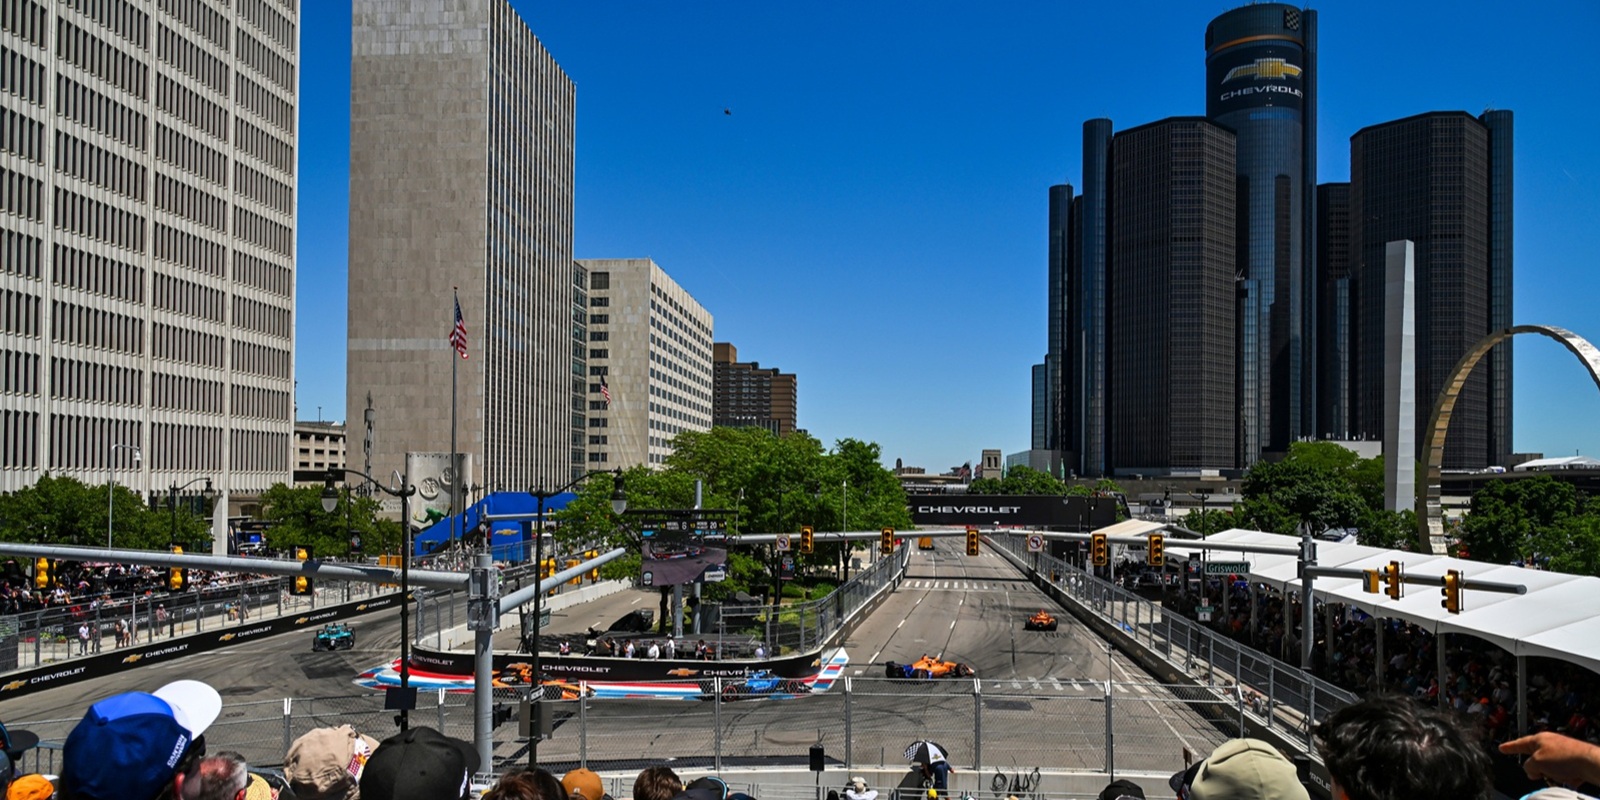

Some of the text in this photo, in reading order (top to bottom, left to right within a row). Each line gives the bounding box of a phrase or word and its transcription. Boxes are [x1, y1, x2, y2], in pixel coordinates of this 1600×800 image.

[918, 505, 1021, 514] CHEVROLET
[1208, 564, 1247, 573] Griswold
[367, 600, 391, 609] CHEVROLET
[309, 611, 338, 621] CHEVROLET
[237, 625, 272, 638] CHEVROLET
[145, 643, 189, 658] CHEVROLET
[413, 654, 454, 666] CHEVROLET
[541, 664, 612, 673] CHEVROLET
[703, 668, 772, 676] CHEVRT
[30, 666, 87, 684] CHEVROLET
